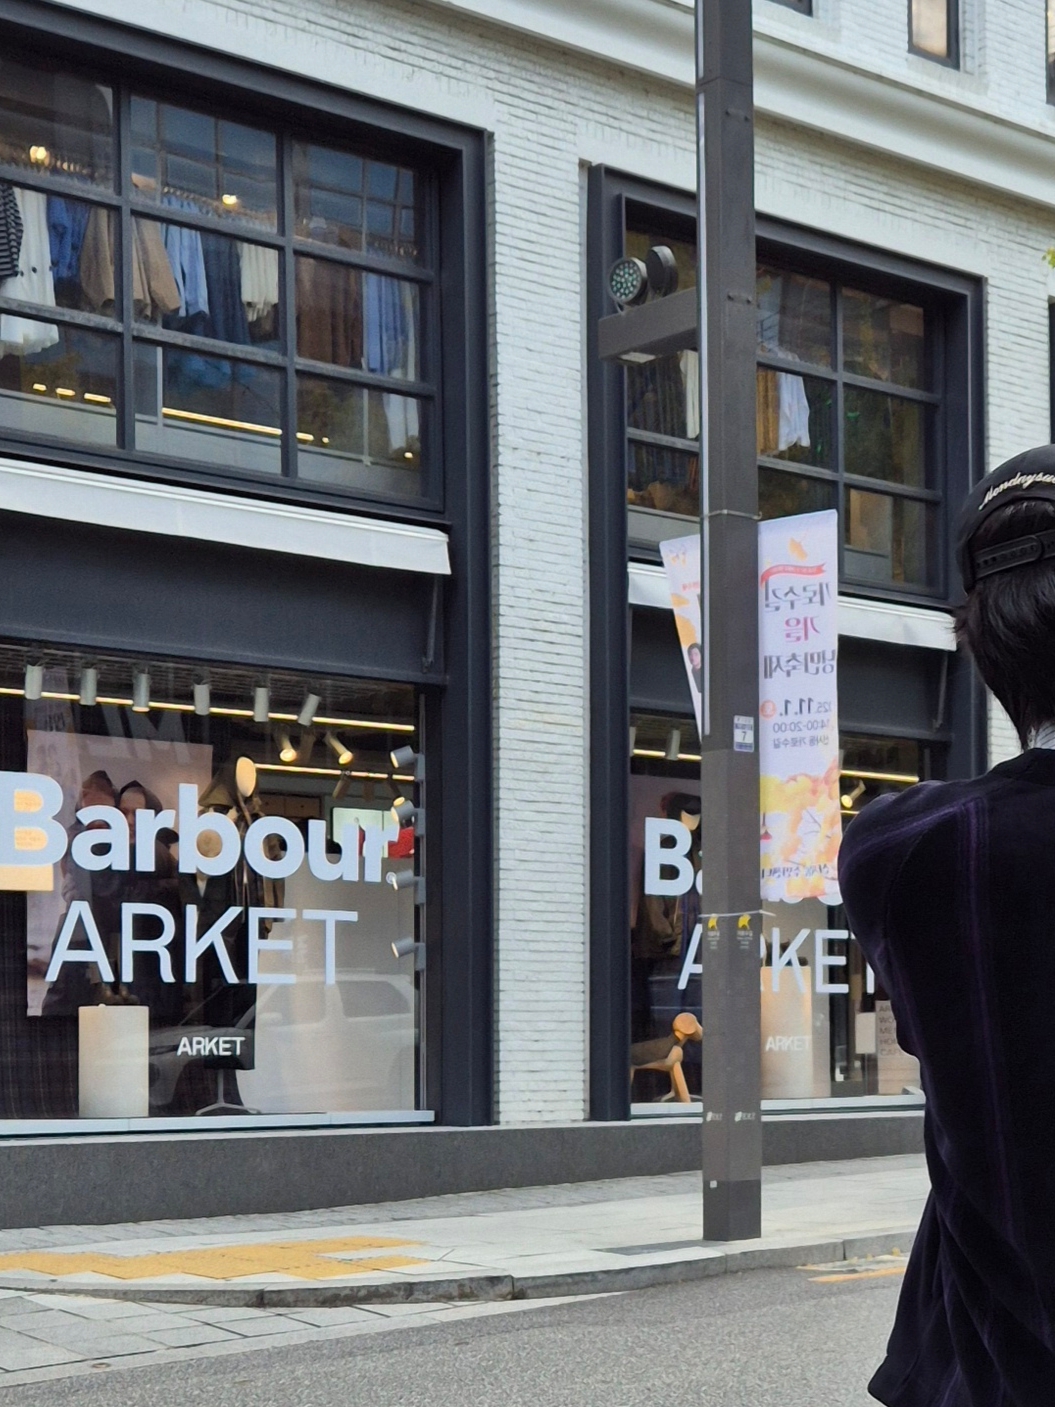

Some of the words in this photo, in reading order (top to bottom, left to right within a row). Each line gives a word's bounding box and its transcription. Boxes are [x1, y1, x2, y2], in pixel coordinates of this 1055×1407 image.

[0, 771, 400, 883] Barbour
[45, 900, 358, 985] ARKET
[177, 1036, 246, 1056] ARKET
[765, 1035, 811, 1051] ARKET
